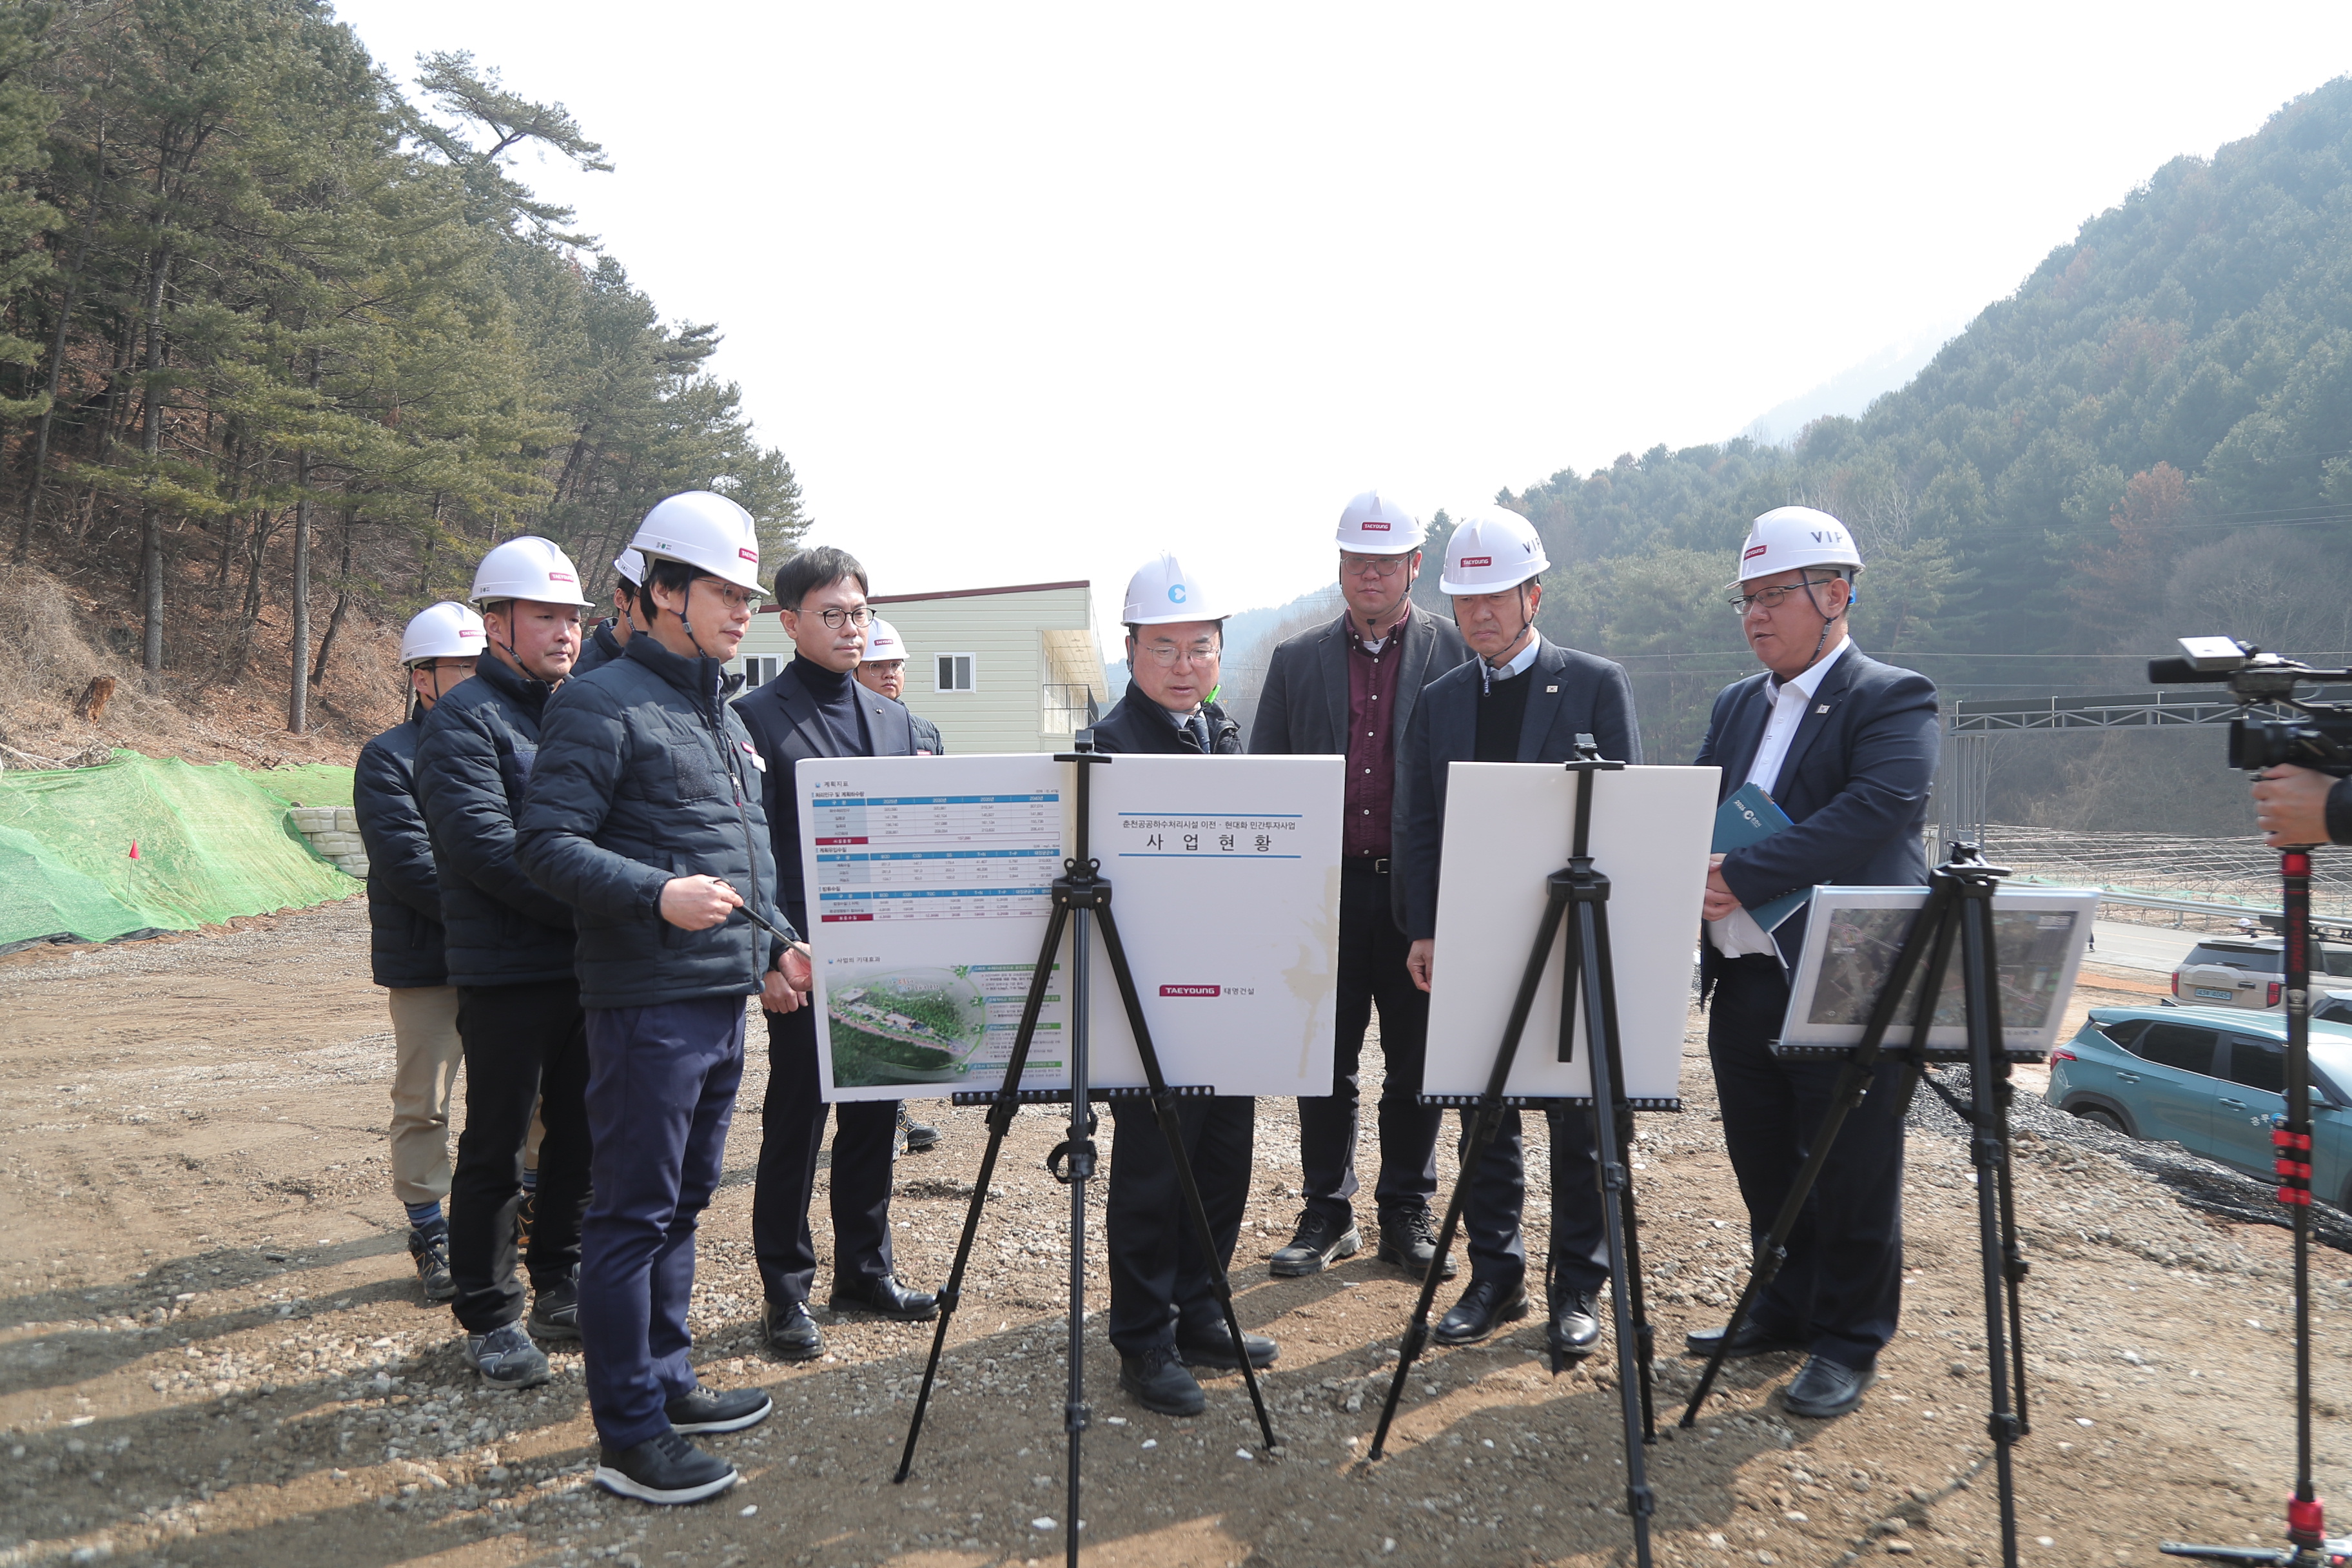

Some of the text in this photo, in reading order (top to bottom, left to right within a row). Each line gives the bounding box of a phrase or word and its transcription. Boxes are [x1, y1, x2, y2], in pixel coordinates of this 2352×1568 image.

[1810, 531, 1843, 543] VIP
[1522, 538, 1540, 554] VIP
[1734, 799, 1746, 811] 2026
[1122, 819, 1199, 828] 춘천공공하수처리시설
[1201, 821, 1217, 829] 이전
[1225, 820, 1248, 829] 현대화
[1250, 821, 1296, 830] 민간투자사업
[1224, 987, 1255, 995] 태영건설
